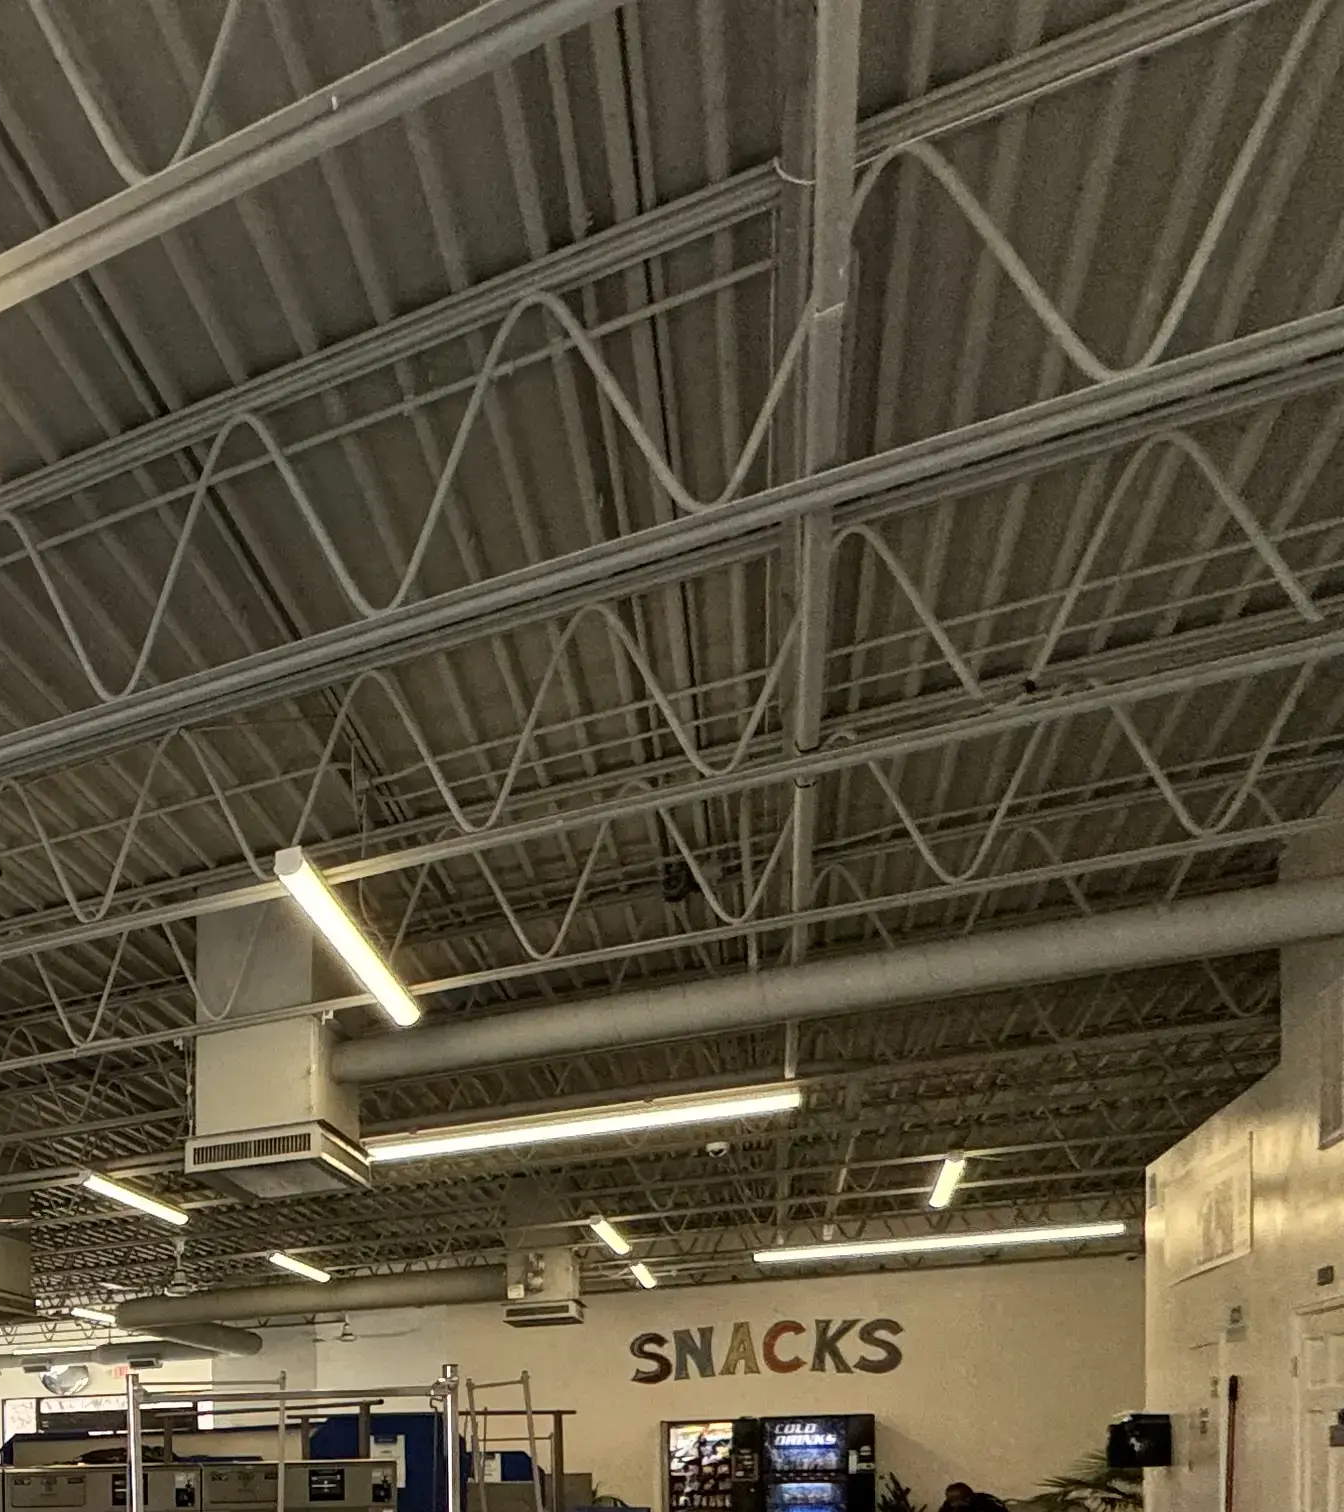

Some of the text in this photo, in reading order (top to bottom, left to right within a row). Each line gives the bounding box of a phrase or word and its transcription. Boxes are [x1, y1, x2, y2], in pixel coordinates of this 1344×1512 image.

[629, 1318, 904, 1384] SNACKS
[774, 1423, 818, 1434] COLD
[774, 1434, 837, 1446] DRINKS
